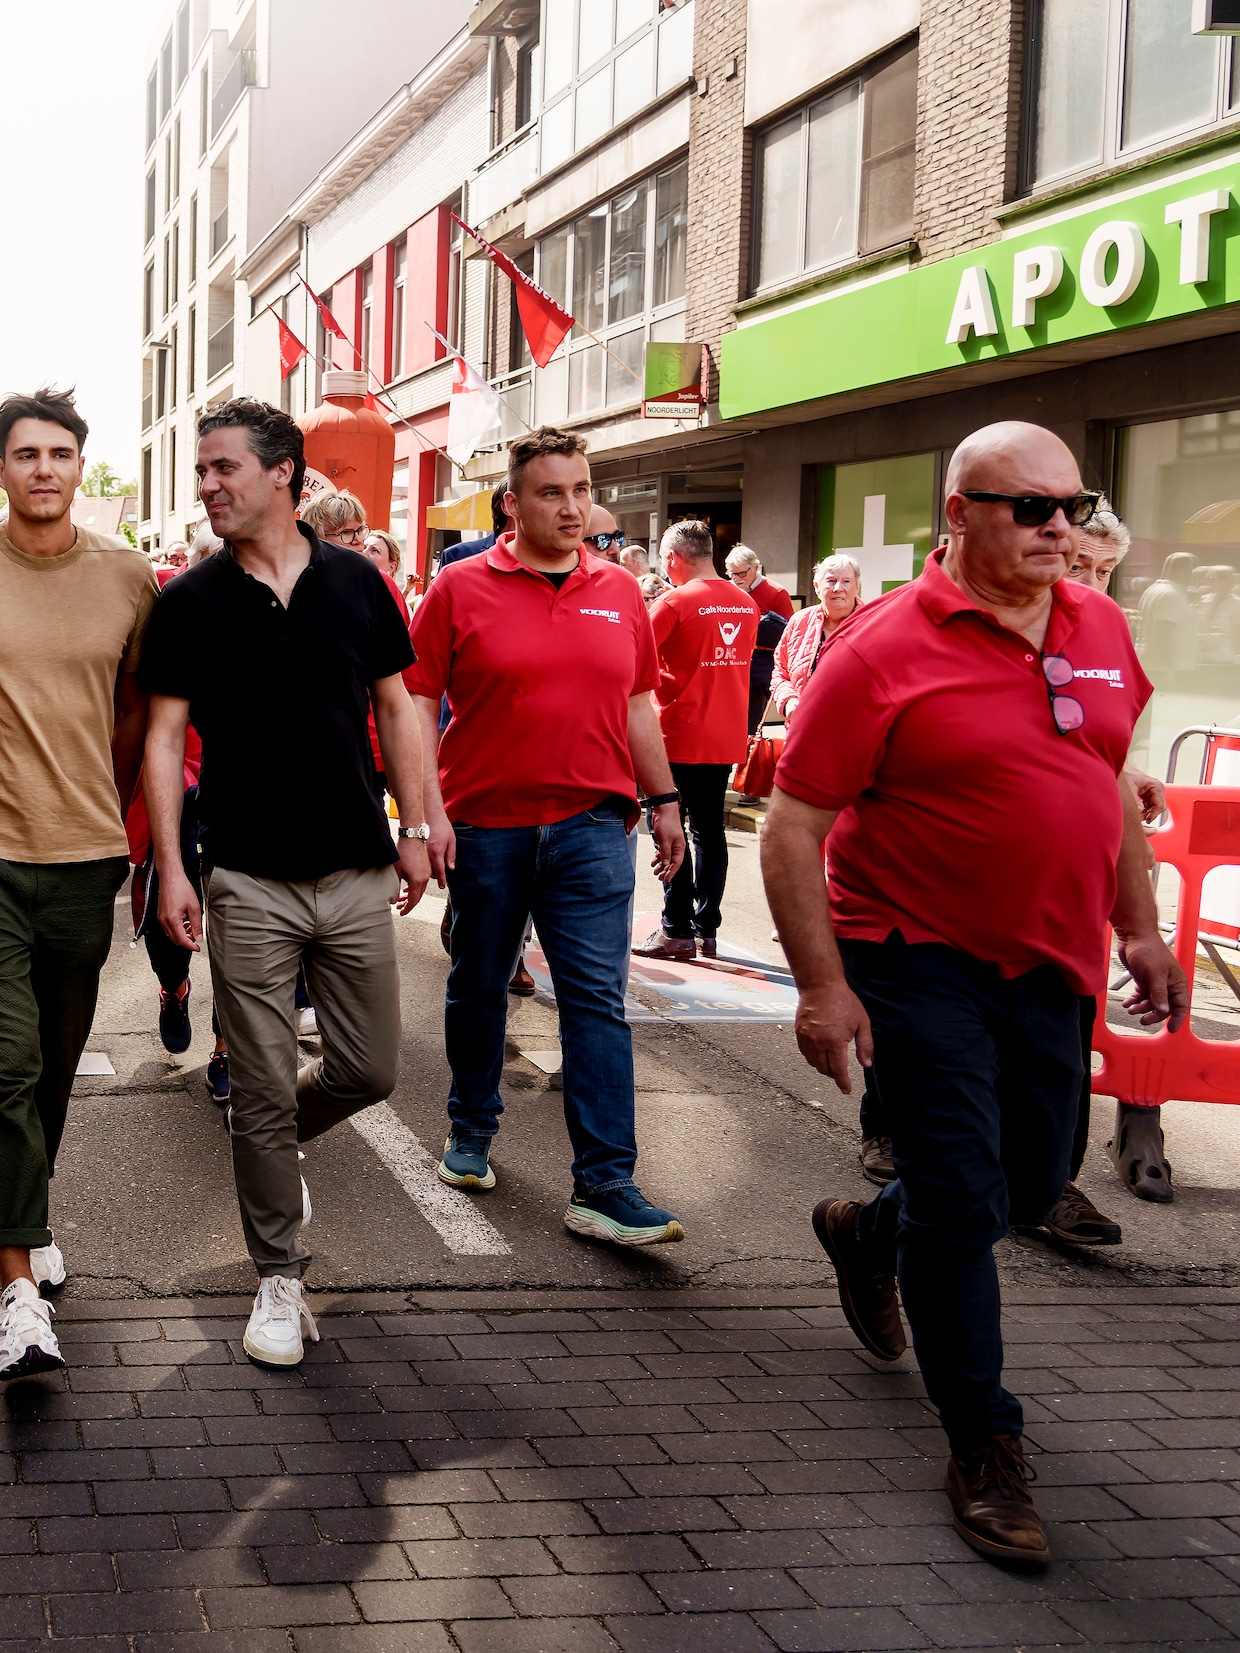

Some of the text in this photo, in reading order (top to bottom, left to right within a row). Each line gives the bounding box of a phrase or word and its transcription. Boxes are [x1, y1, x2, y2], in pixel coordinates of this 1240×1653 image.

[945, 188, 1231, 344] APOT
[647, 406, 698, 415] NOORDERLICHT
[579, 608, 620, 620] VOORUIT
[1073, 669, 1121, 681] VOORUIT
[742, 1001, 798, 1014] ga
